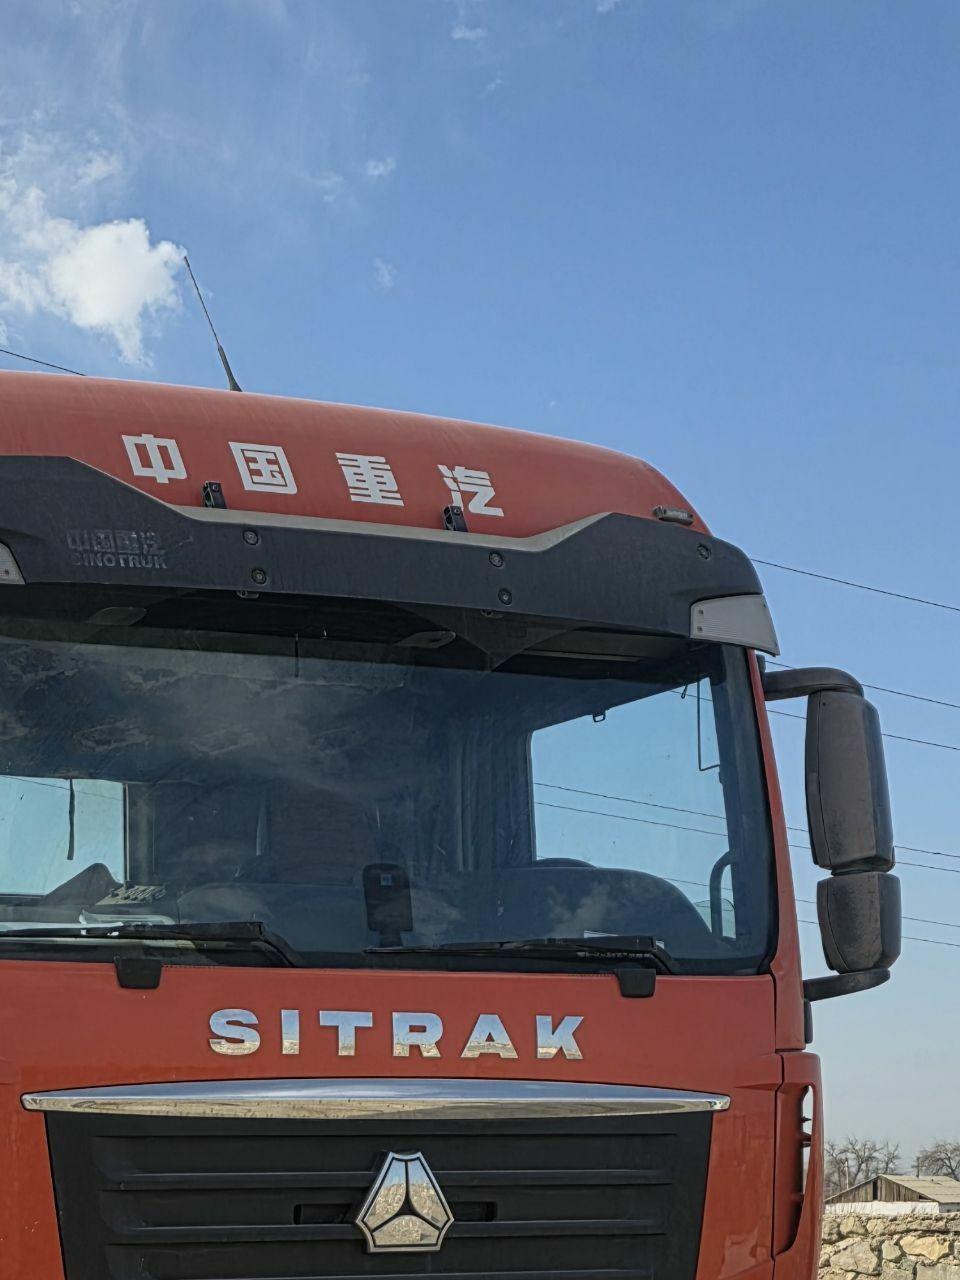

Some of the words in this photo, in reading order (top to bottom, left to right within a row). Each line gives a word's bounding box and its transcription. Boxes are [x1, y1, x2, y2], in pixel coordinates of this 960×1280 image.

[121, 433, 505, 517] 中国重汽
[71, 552, 168, 569] SINOTRUK
[208, 1008, 585, 1060] SITRAK
